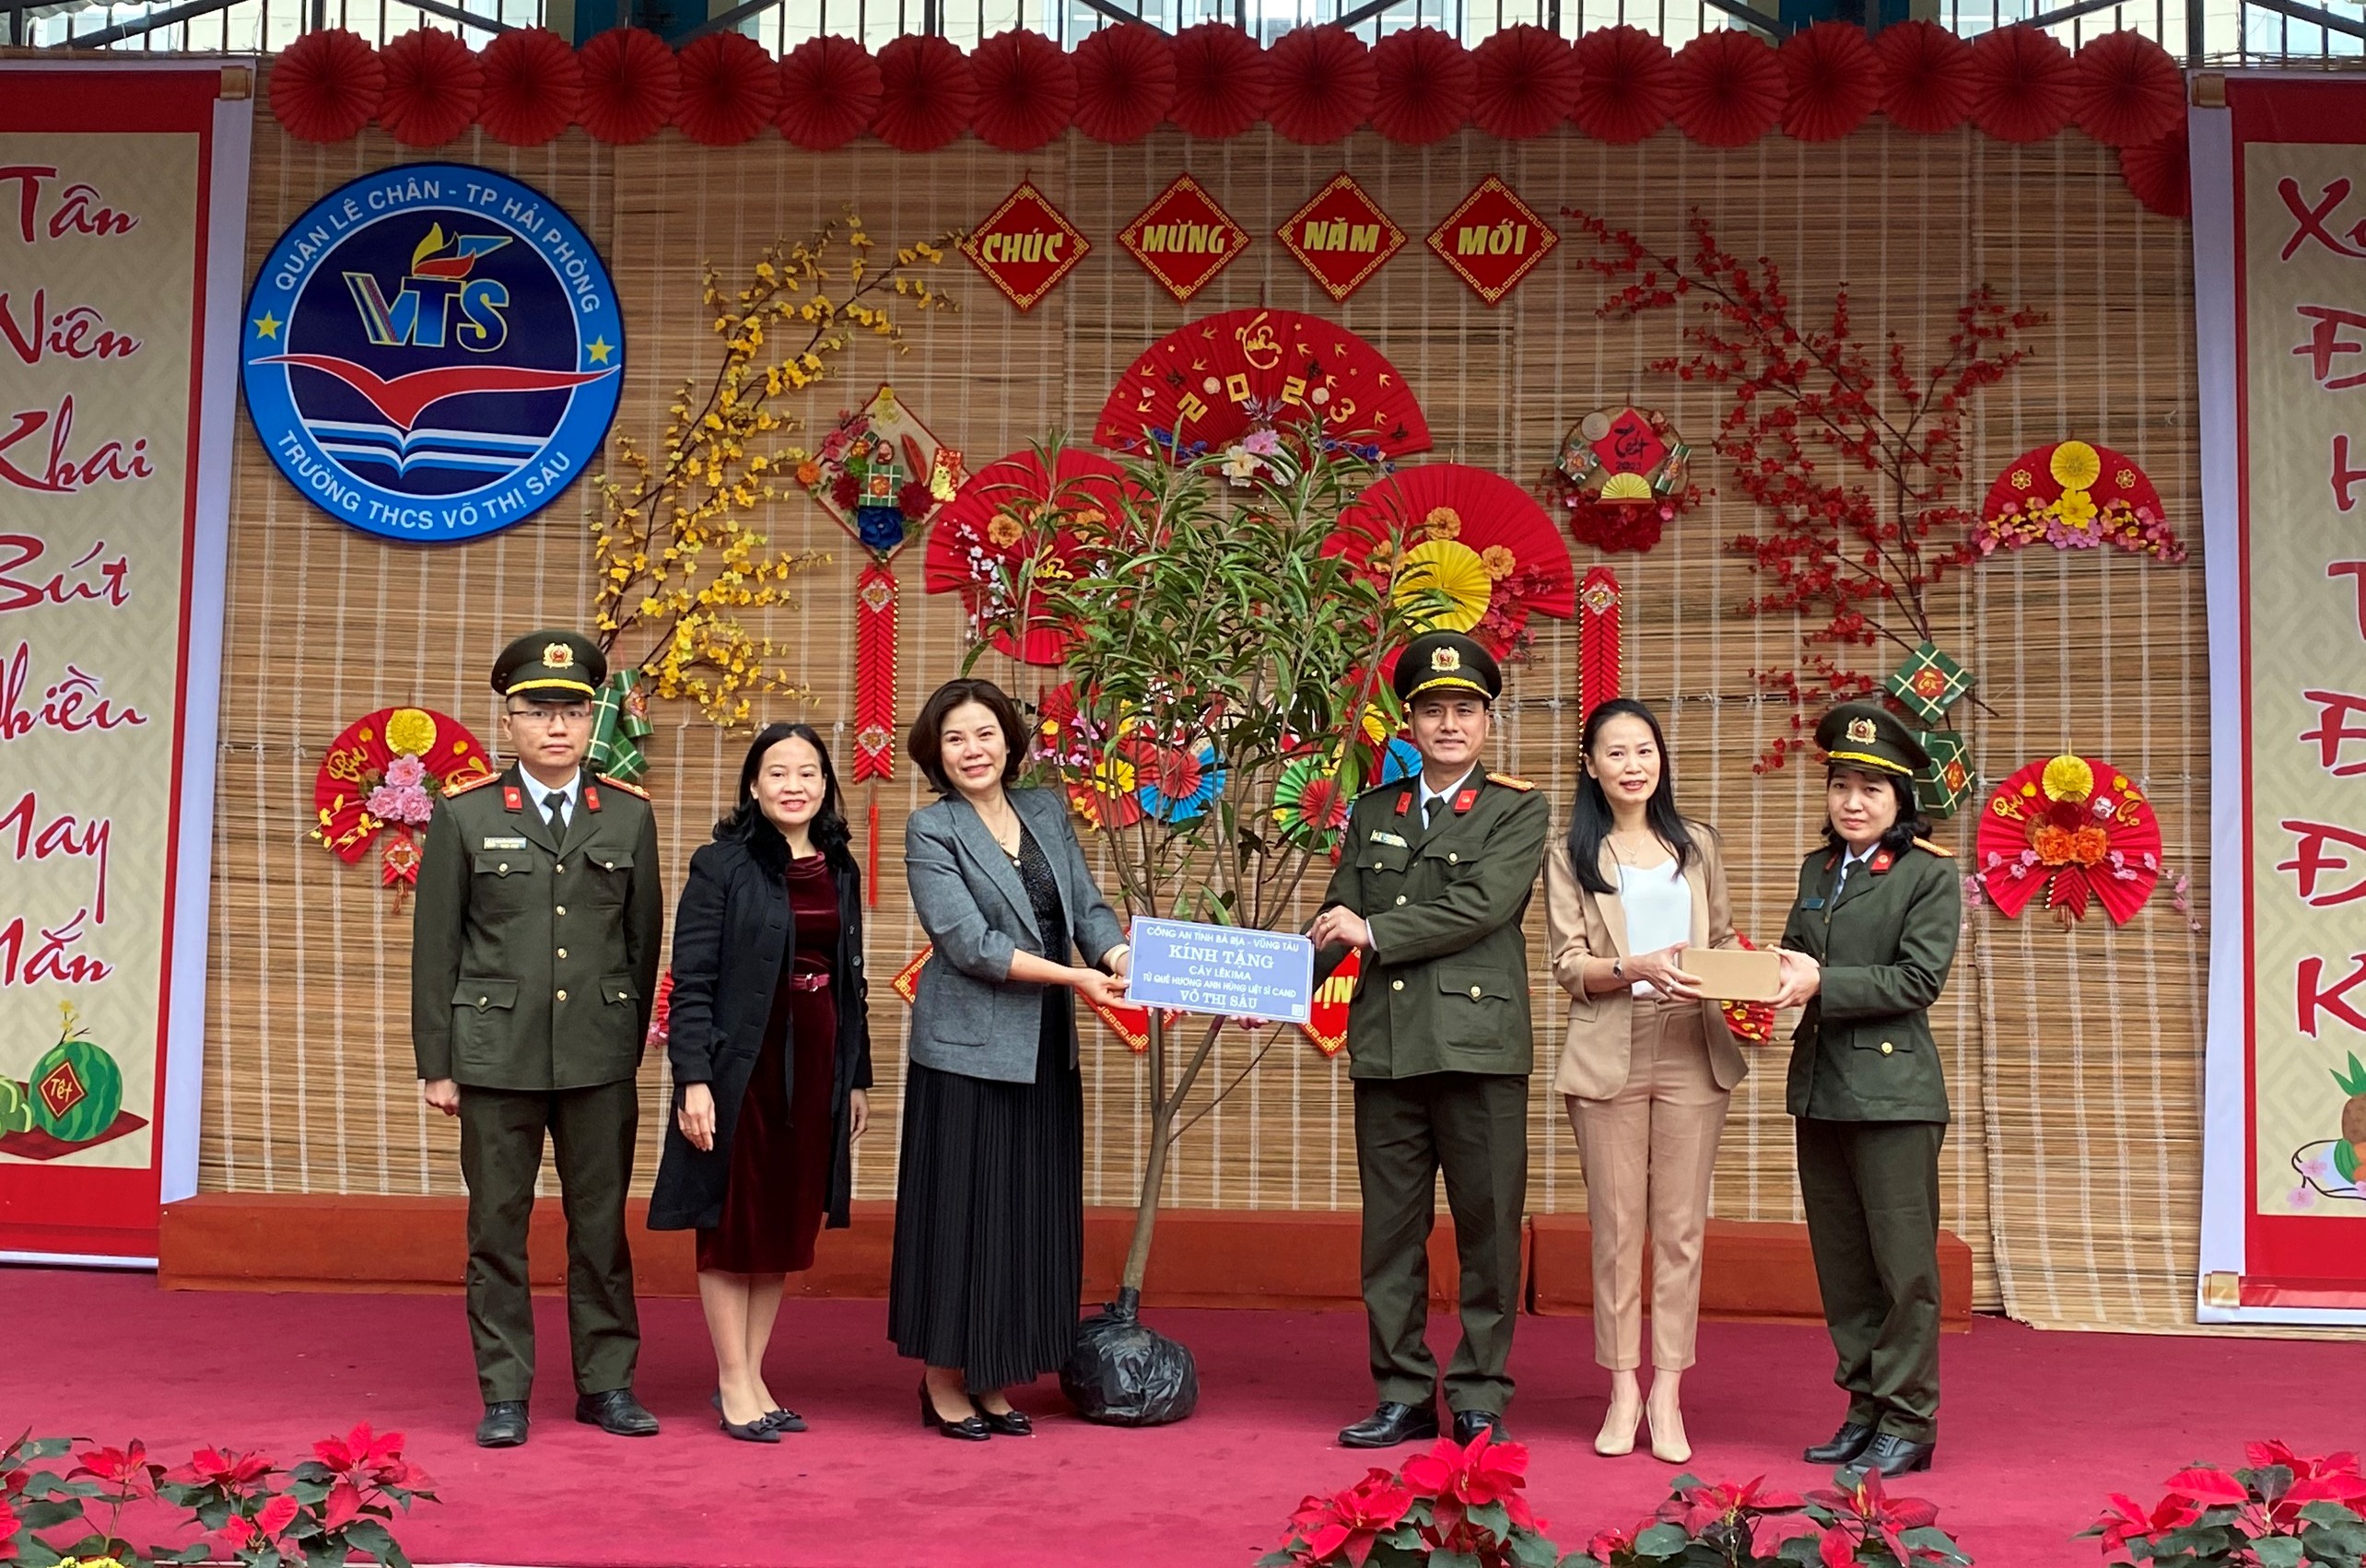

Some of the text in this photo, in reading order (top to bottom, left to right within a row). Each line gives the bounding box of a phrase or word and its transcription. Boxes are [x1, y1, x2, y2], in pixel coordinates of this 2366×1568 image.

[0, 167, 139, 243] Tân
[275, 230, 330, 291] QUẬN
[329, 198, 363, 230] LÊ
[369, 177, 439, 210] CHÂN
[466, 183, 498, 206] TP
[502, 202, 545, 234] HẢI
[542, 228, 601, 314] PHÒNG
[982, 216, 1528, 263] CHÚC MỪNG NĂM MỚI
[342, 271, 510, 353] VTS
[277, 429, 571, 530] TRƯỜNG THCS VÕ THỊ SÁU
[0, 642, 146, 739] hiều
[1146, 926, 1177, 938] CÔNG
[1177, 930, 1192, 940] AN
[1168, 942, 1274, 968] KÍNH TẶNG
[1189, 965, 1252, 981] CÂY LÊKIMA
[1203, 980, 1222, 989] ANH
[1271, 987, 1296, 998] CAND
[1202, 992, 1226, 1008] THỊ
[1229, 993, 1258, 1009] SÁU
